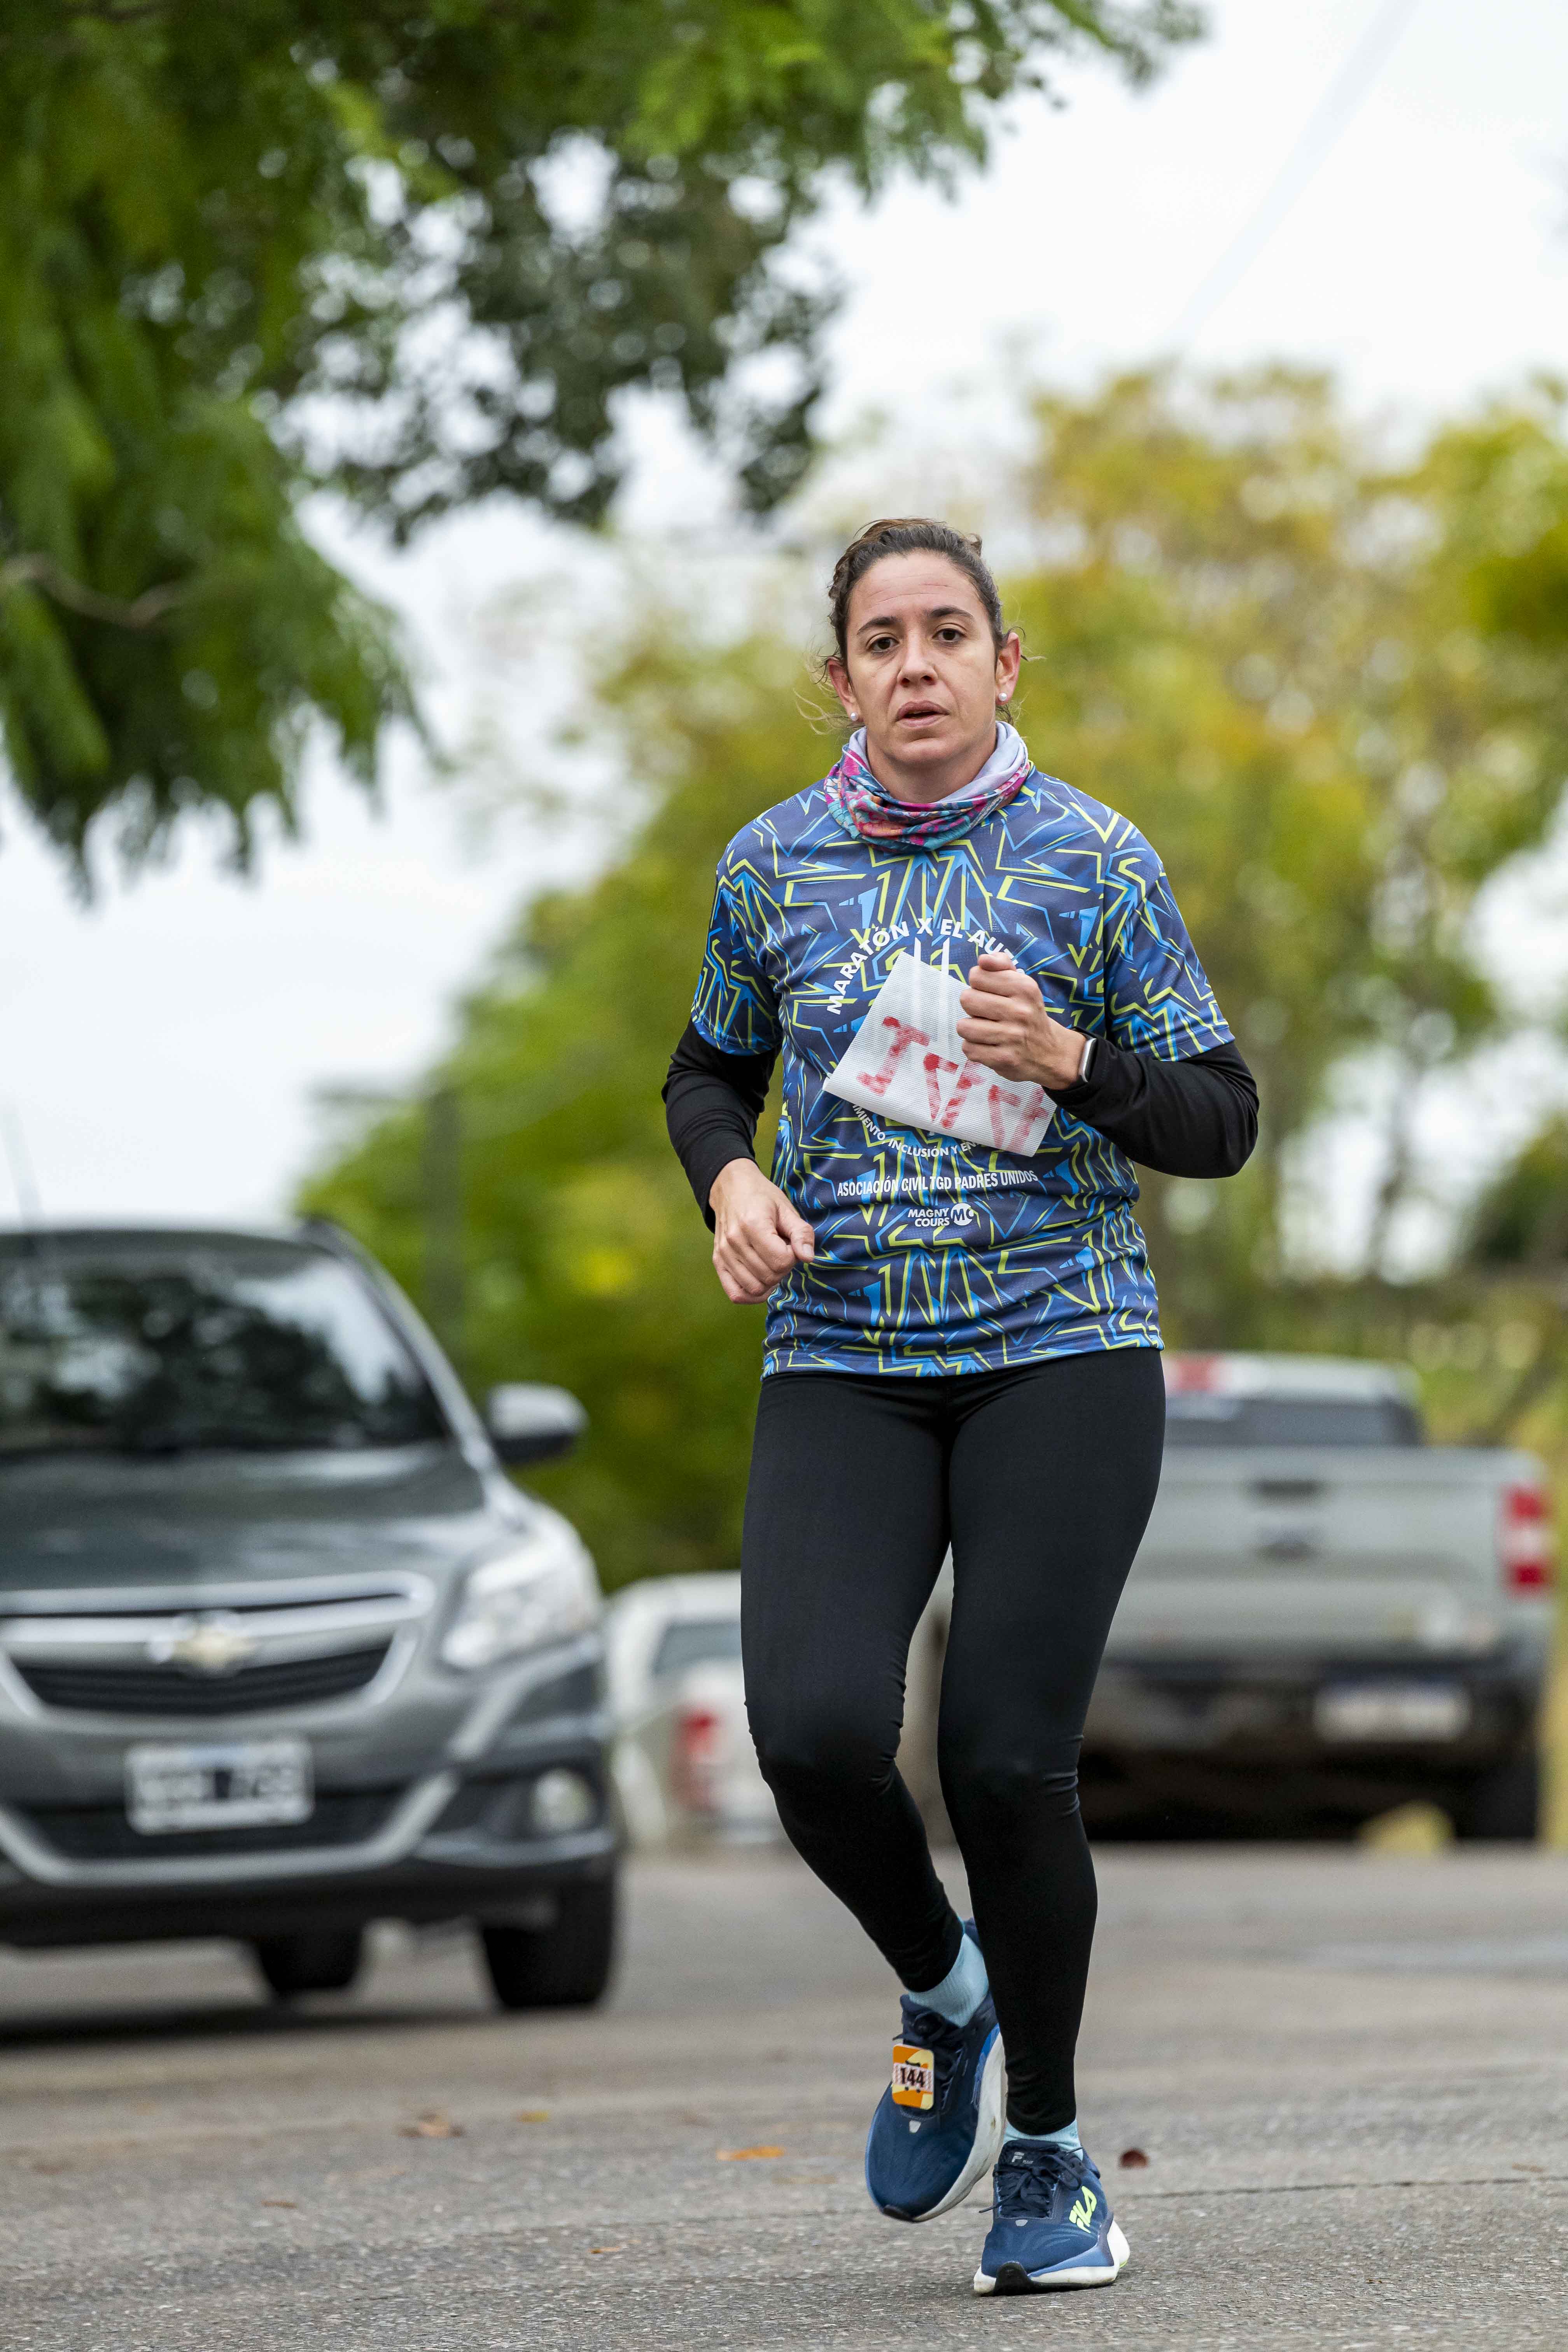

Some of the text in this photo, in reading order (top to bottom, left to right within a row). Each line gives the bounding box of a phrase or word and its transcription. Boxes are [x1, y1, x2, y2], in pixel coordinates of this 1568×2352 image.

[827, 921, 910, 1015] MARATÓN
[917, 918, 933, 934] X
[940, 919, 963, 939] EL
[888, 1139, 949, 1158] INCLUSIÓN
[950, 1145, 958, 1154] Y
[837, 1170, 1038, 1197] ASOCIACIÓN CIVIL TGD PADRES UNIDOS
[907, 1208, 950, 1218] MAGNY
[914, 1217, 950, 1227] COURS
[900, 2067, 925, 2088] 144
